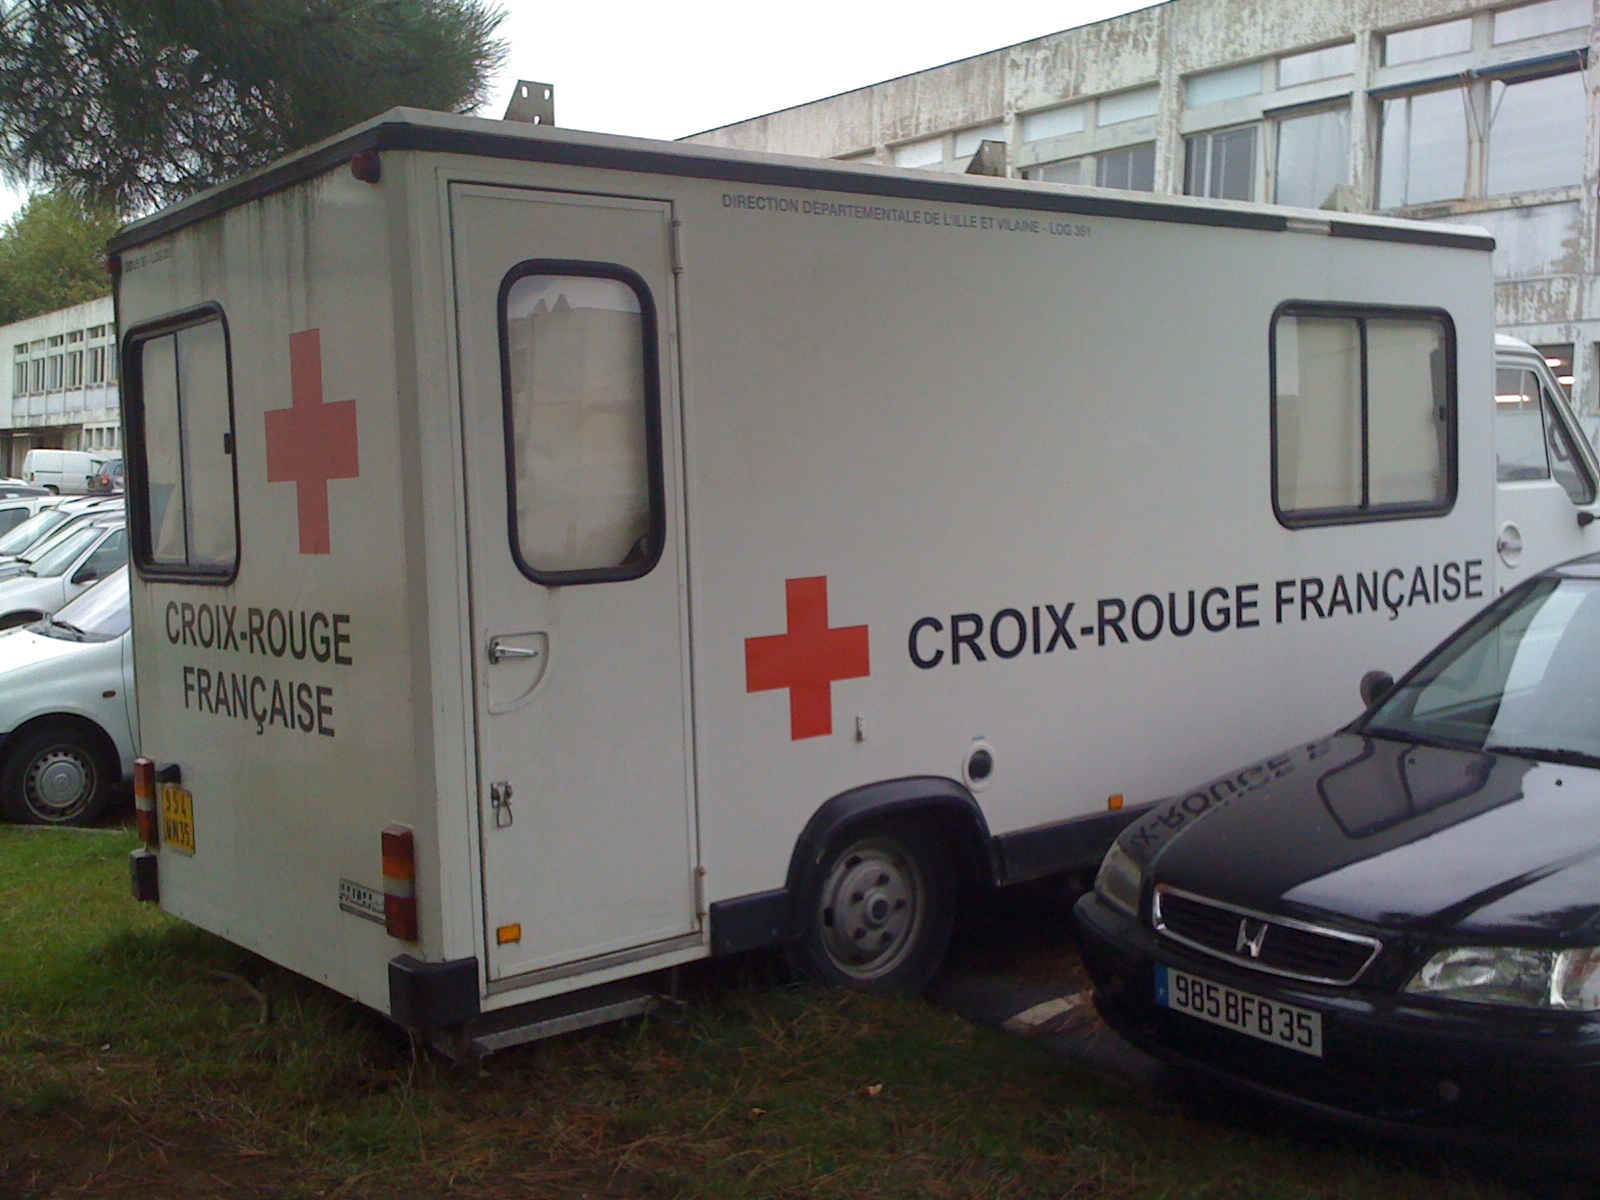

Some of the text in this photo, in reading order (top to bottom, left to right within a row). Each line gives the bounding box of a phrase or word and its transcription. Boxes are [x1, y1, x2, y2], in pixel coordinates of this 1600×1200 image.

[722, 194, 799, 213] DIRECTION
[924, 211, 940, 226] DE
[980, 215, 995, 230] ET
[996, 217, 1040, 234] VILAINE
[1050, 221, 1072, 237] LOG
[165, 601, 353, 666] CROIX-ROUGE
[907, 559, 1483, 670] CROIX-ROUGE FRANÇAISE
[183, 666, 336, 737] FRANÇAISE
[1176, 974, 1313, 1048] 985 BFB 35
